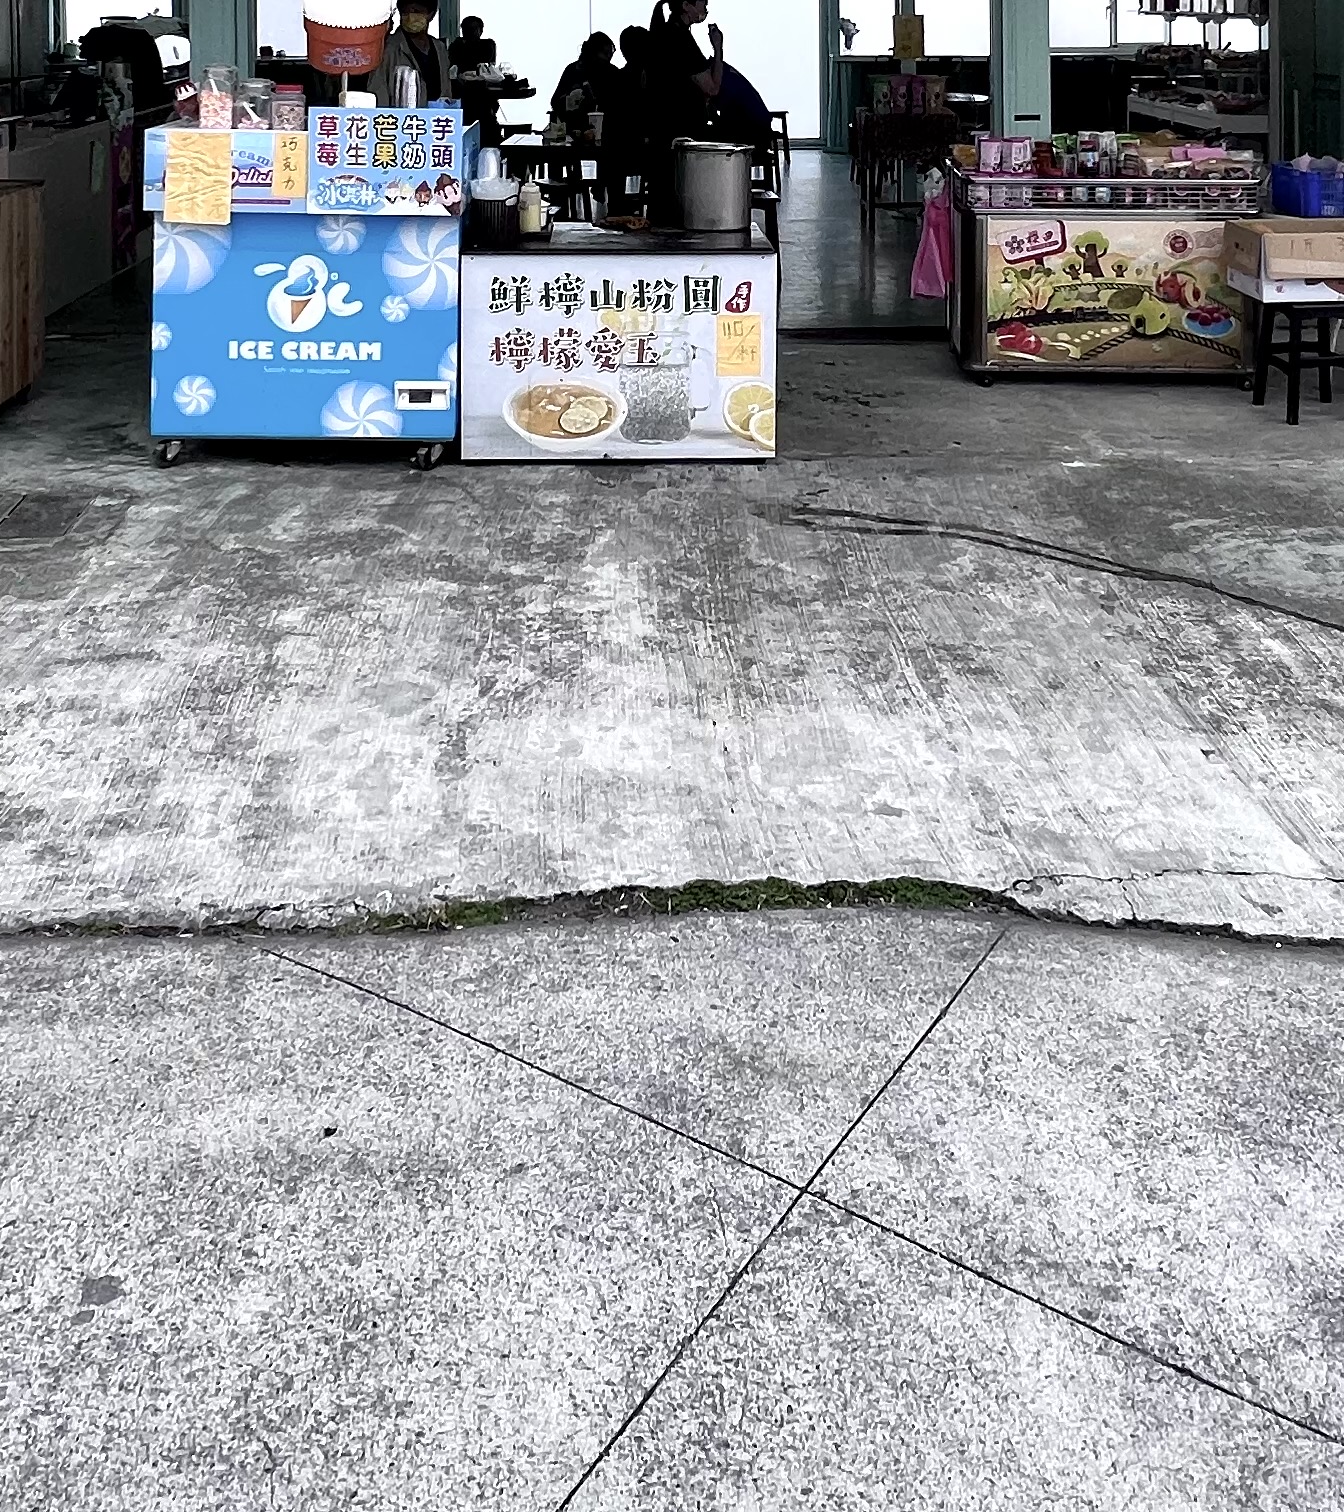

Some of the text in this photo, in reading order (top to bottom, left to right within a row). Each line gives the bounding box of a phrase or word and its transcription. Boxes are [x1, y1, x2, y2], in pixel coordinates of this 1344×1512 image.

[317, 115, 340, 167] 草莓
[346, 115, 369, 167] 花生
[373, 114, 399, 170] 芒果
[401, 114, 428, 170] 牛奶
[431, 116, 455, 169] 芋頭
[488, 272, 722, 317] 鮮檸山粉圓
[731, 284, 749, 312] 手作
[228, 339, 382, 362] ICE CREAM
[488, 327, 664, 374] 檸檬愛玉
